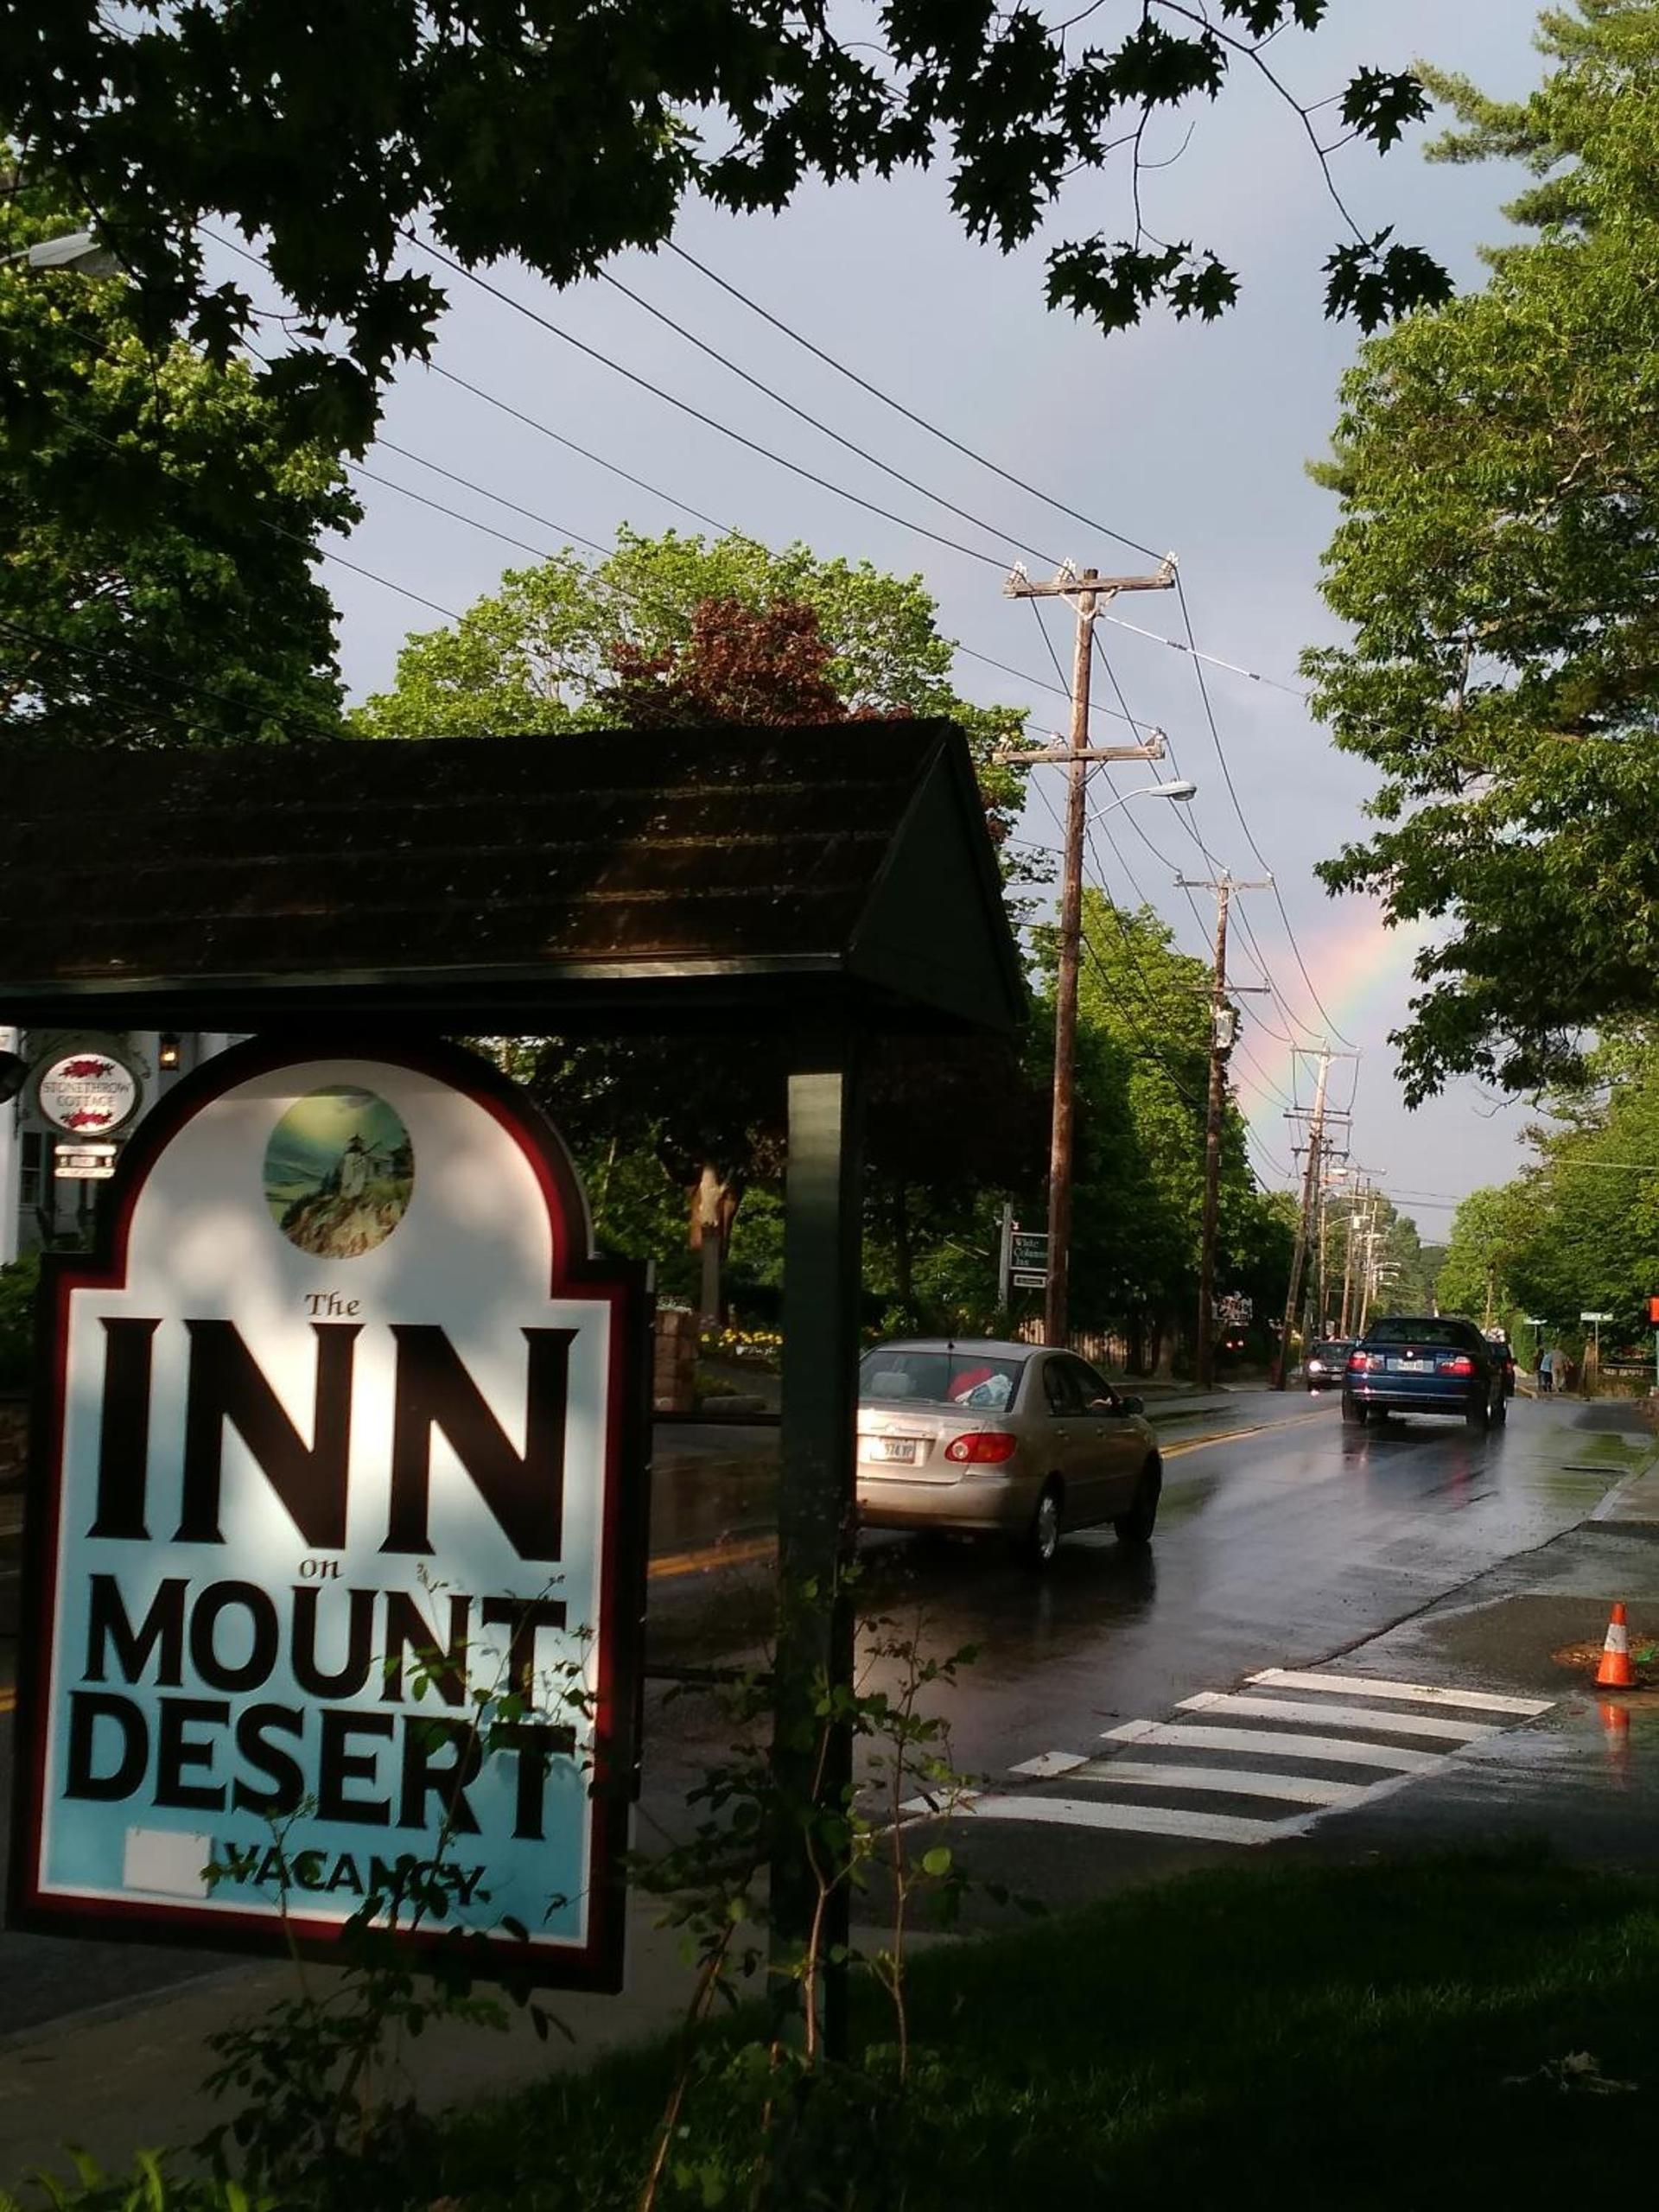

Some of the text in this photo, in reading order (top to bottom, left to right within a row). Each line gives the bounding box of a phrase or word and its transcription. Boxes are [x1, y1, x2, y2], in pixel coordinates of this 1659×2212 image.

[56, 1095, 115, 1107] COTTAGE
[304, 1291, 360, 1316] The
[85, 1317, 580, 1562] INN
[299, 1558, 345, 1580] on
[80, 1573, 567, 1713] MOUNT
[62, 1690, 576, 1840] DESERT
